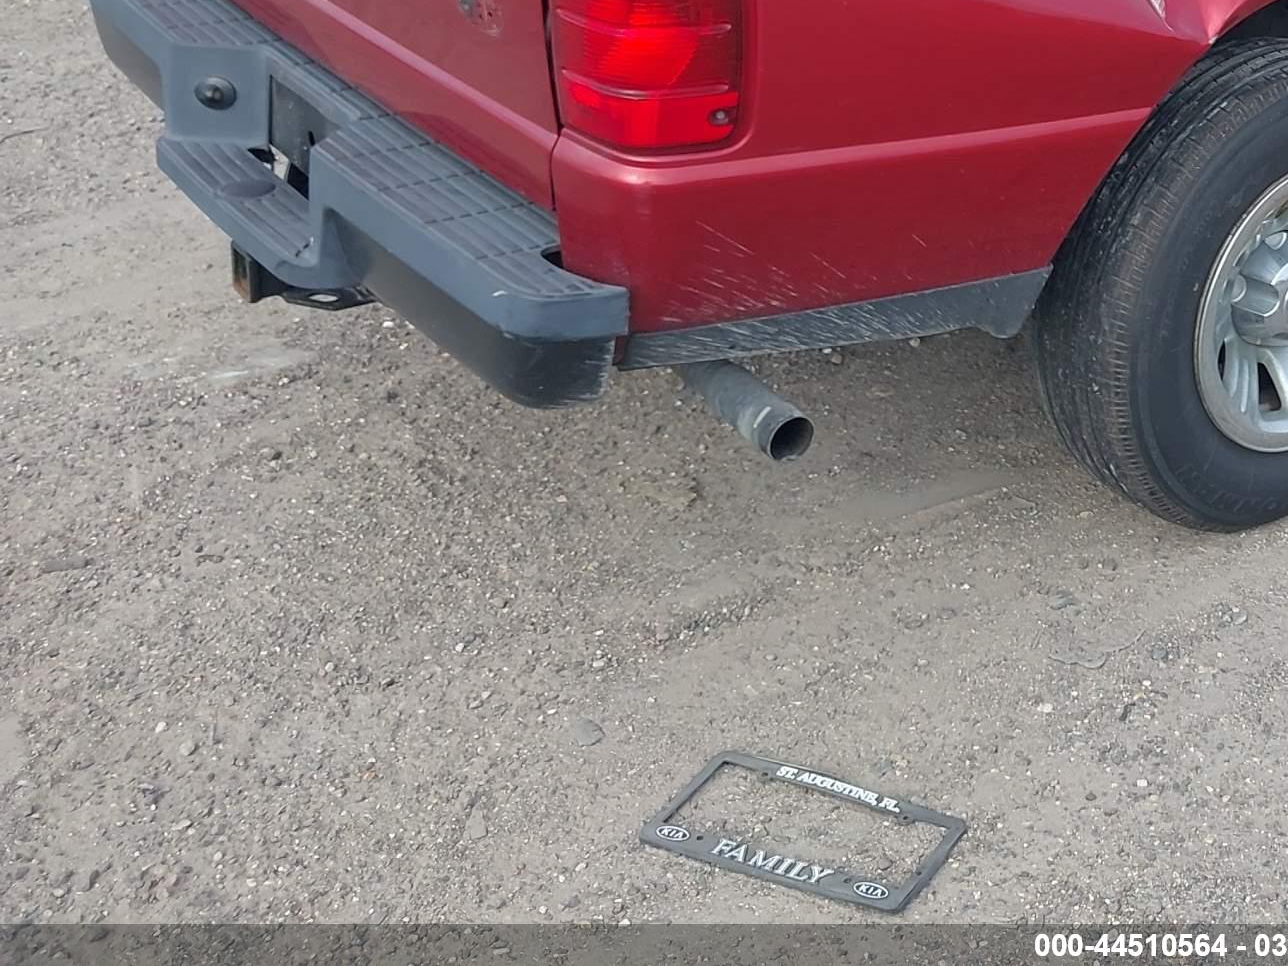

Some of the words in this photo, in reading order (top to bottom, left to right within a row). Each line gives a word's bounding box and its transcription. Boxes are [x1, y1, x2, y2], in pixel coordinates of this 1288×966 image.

[776, 766, 798, 779] ST.
[796, 772, 879, 806] AUGUSTINE,
[711, 838, 835, 883] FAMILY
